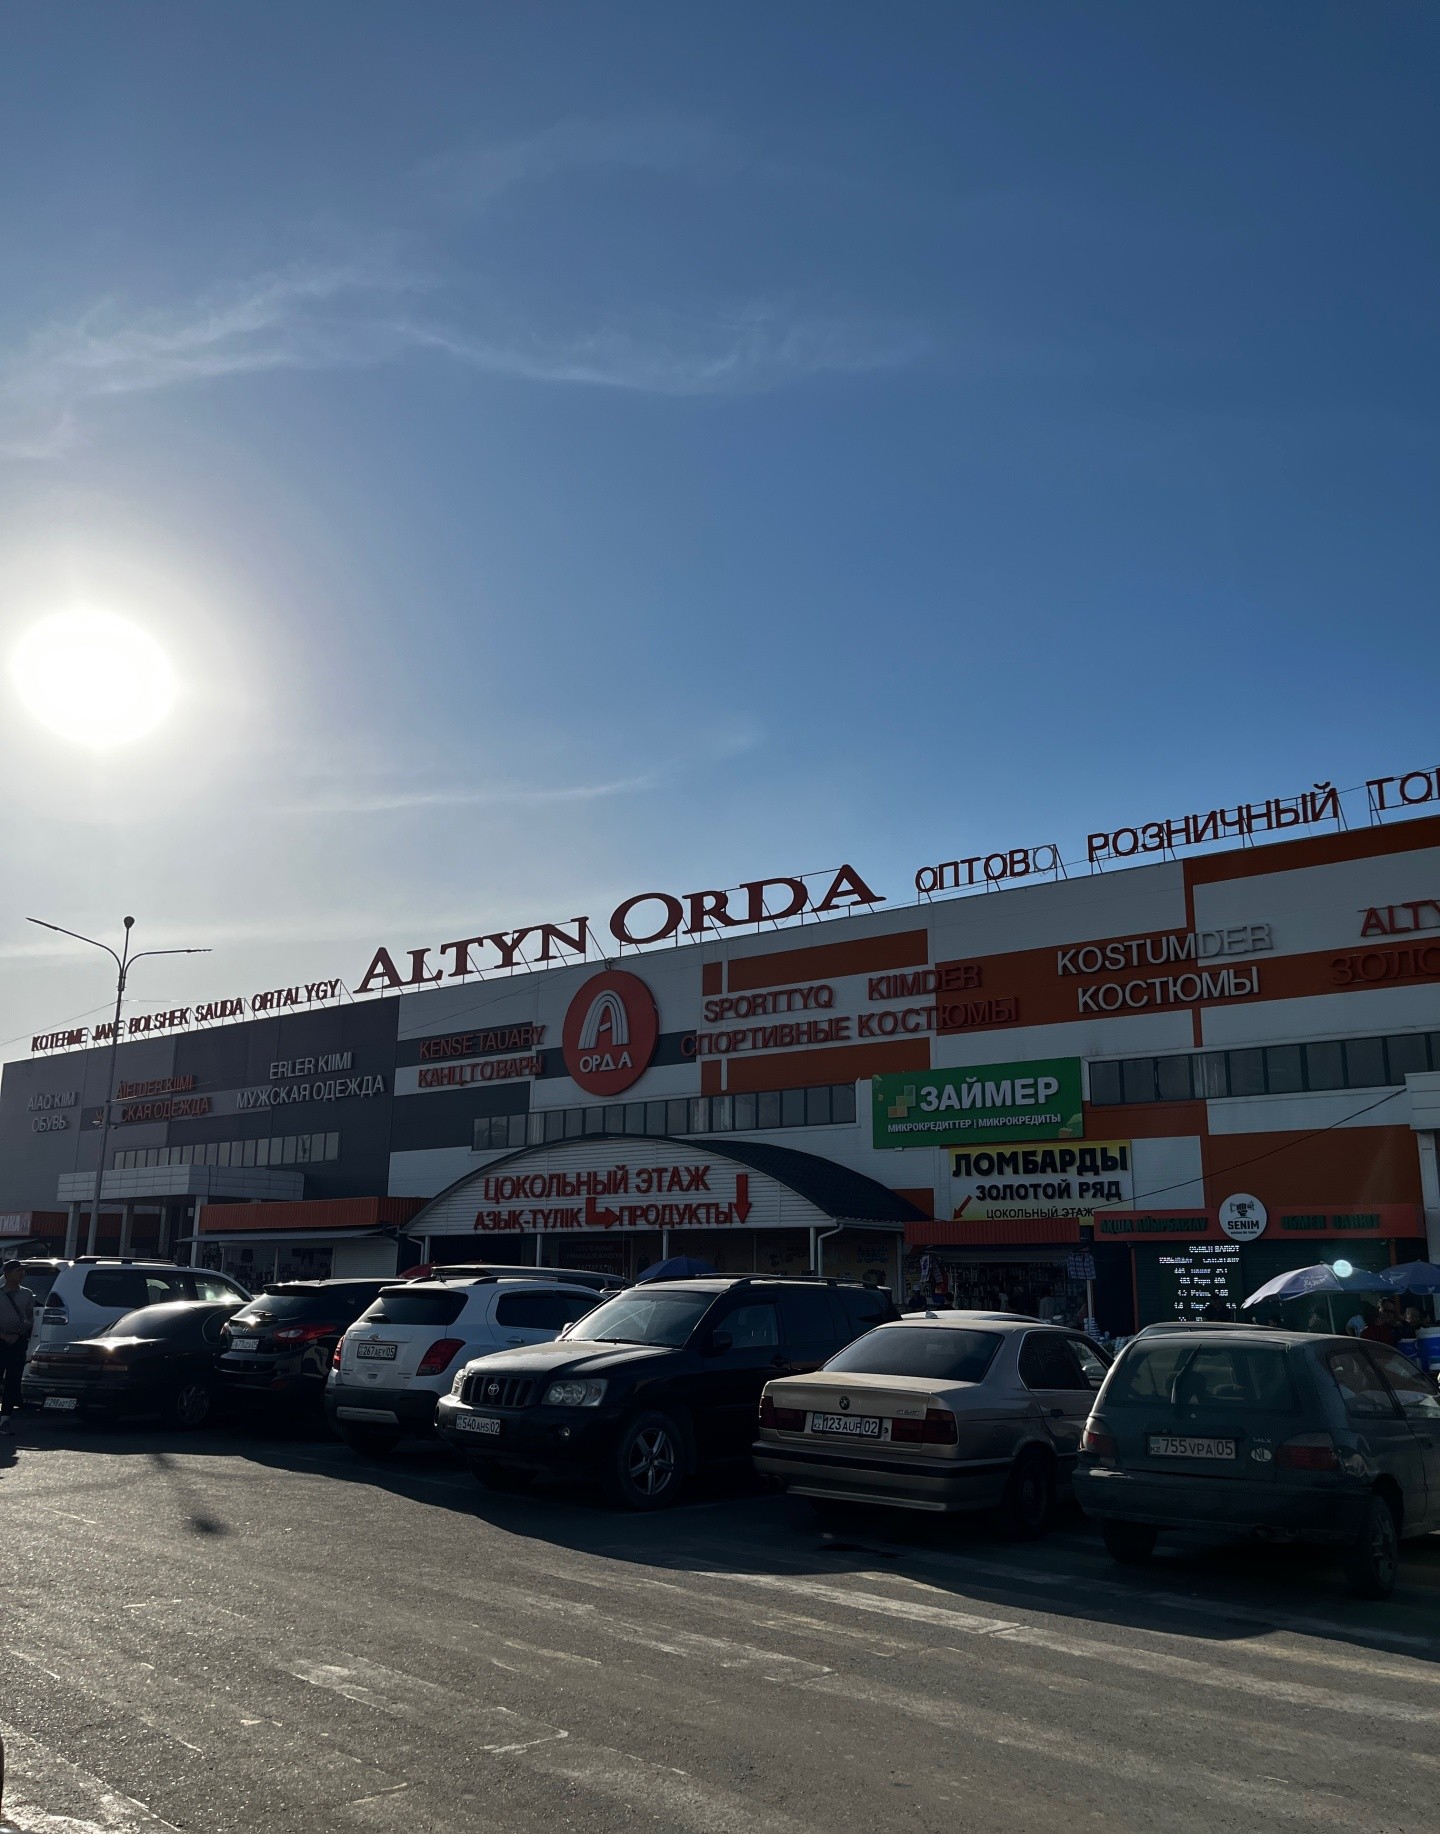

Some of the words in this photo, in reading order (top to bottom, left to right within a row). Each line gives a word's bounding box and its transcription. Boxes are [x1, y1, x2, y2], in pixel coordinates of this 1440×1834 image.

[916, 845, 1057, 893] ОПТОВО
[1087, 781, 1339, 862] РОЗНИЧНЫЙ
[1366, 768, 1440, 810] ТО
[353, 917, 589, 994] ALTYN
[609, 864, 886, 945] ORDA
[1057, 923, 1274, 977] KOSTUMDER
[129, 1007, 190, 1035] BOLSHEK
[195, 998, 245, 1023] SAUDA
[251, 978, 341, 1013] ORTALYGY
[704, 984, 834, 1023] SPORTTYQ
[868, 964, 982, 1001] KIIMDER
[1077, 966, 1260, 1013] КОСТЮМЫ
[419, 1034, 473, 1060] KENSE
[478, 1025, 546, 1051] TAUARY
[680, 1016, 851, 1057] СПОРТИВНЫЕ
[858, 996, 1019, 1038] КОСТЮМЫ
[269, 1056, 315, 1080] ERLER
[317, 1051, 354, 1075] KIIMI
[579, 1051, 633, 1073] ОРДА
[154, 1096, 212, 1121] ОДЕЖДА
[236, 1083, 311, 1110] МУЖСКАЯ
[313, 1074, 386, 1103] ОДЕЖДА
[920, 1076, 1060, 1112] ЗАЙМЕР
[32, 1115, 67, 1133] ОБУВЬ
[887, 1118, 972, 1134] МИКРОКРЕДИТТЕР
[978, 1113, 1062, 1129] МИКРОКРЕДИТЫ
[952, 1146, 1128, 1178] ЛОМБАРДЫ
[484, 1165, 629, 1204] ЦОКОЛЬНЫЙ
[635, 1165, 711, 1195] ЭТАЖ
[975, 1179, 1072, 1202] ЗОЛОТОЙ
[1078, 1180, 1123, 1201] РЯД
[618, 1202, 734, 1230] ПРОДУКТЫ
[986, 1205, 1058, 1220] ЦОКОЛЬНЫЙ
[1061, 1206, 1095, 1219] ЭТАЖ
[1227, 1220, 1260, 1230] SENIM
